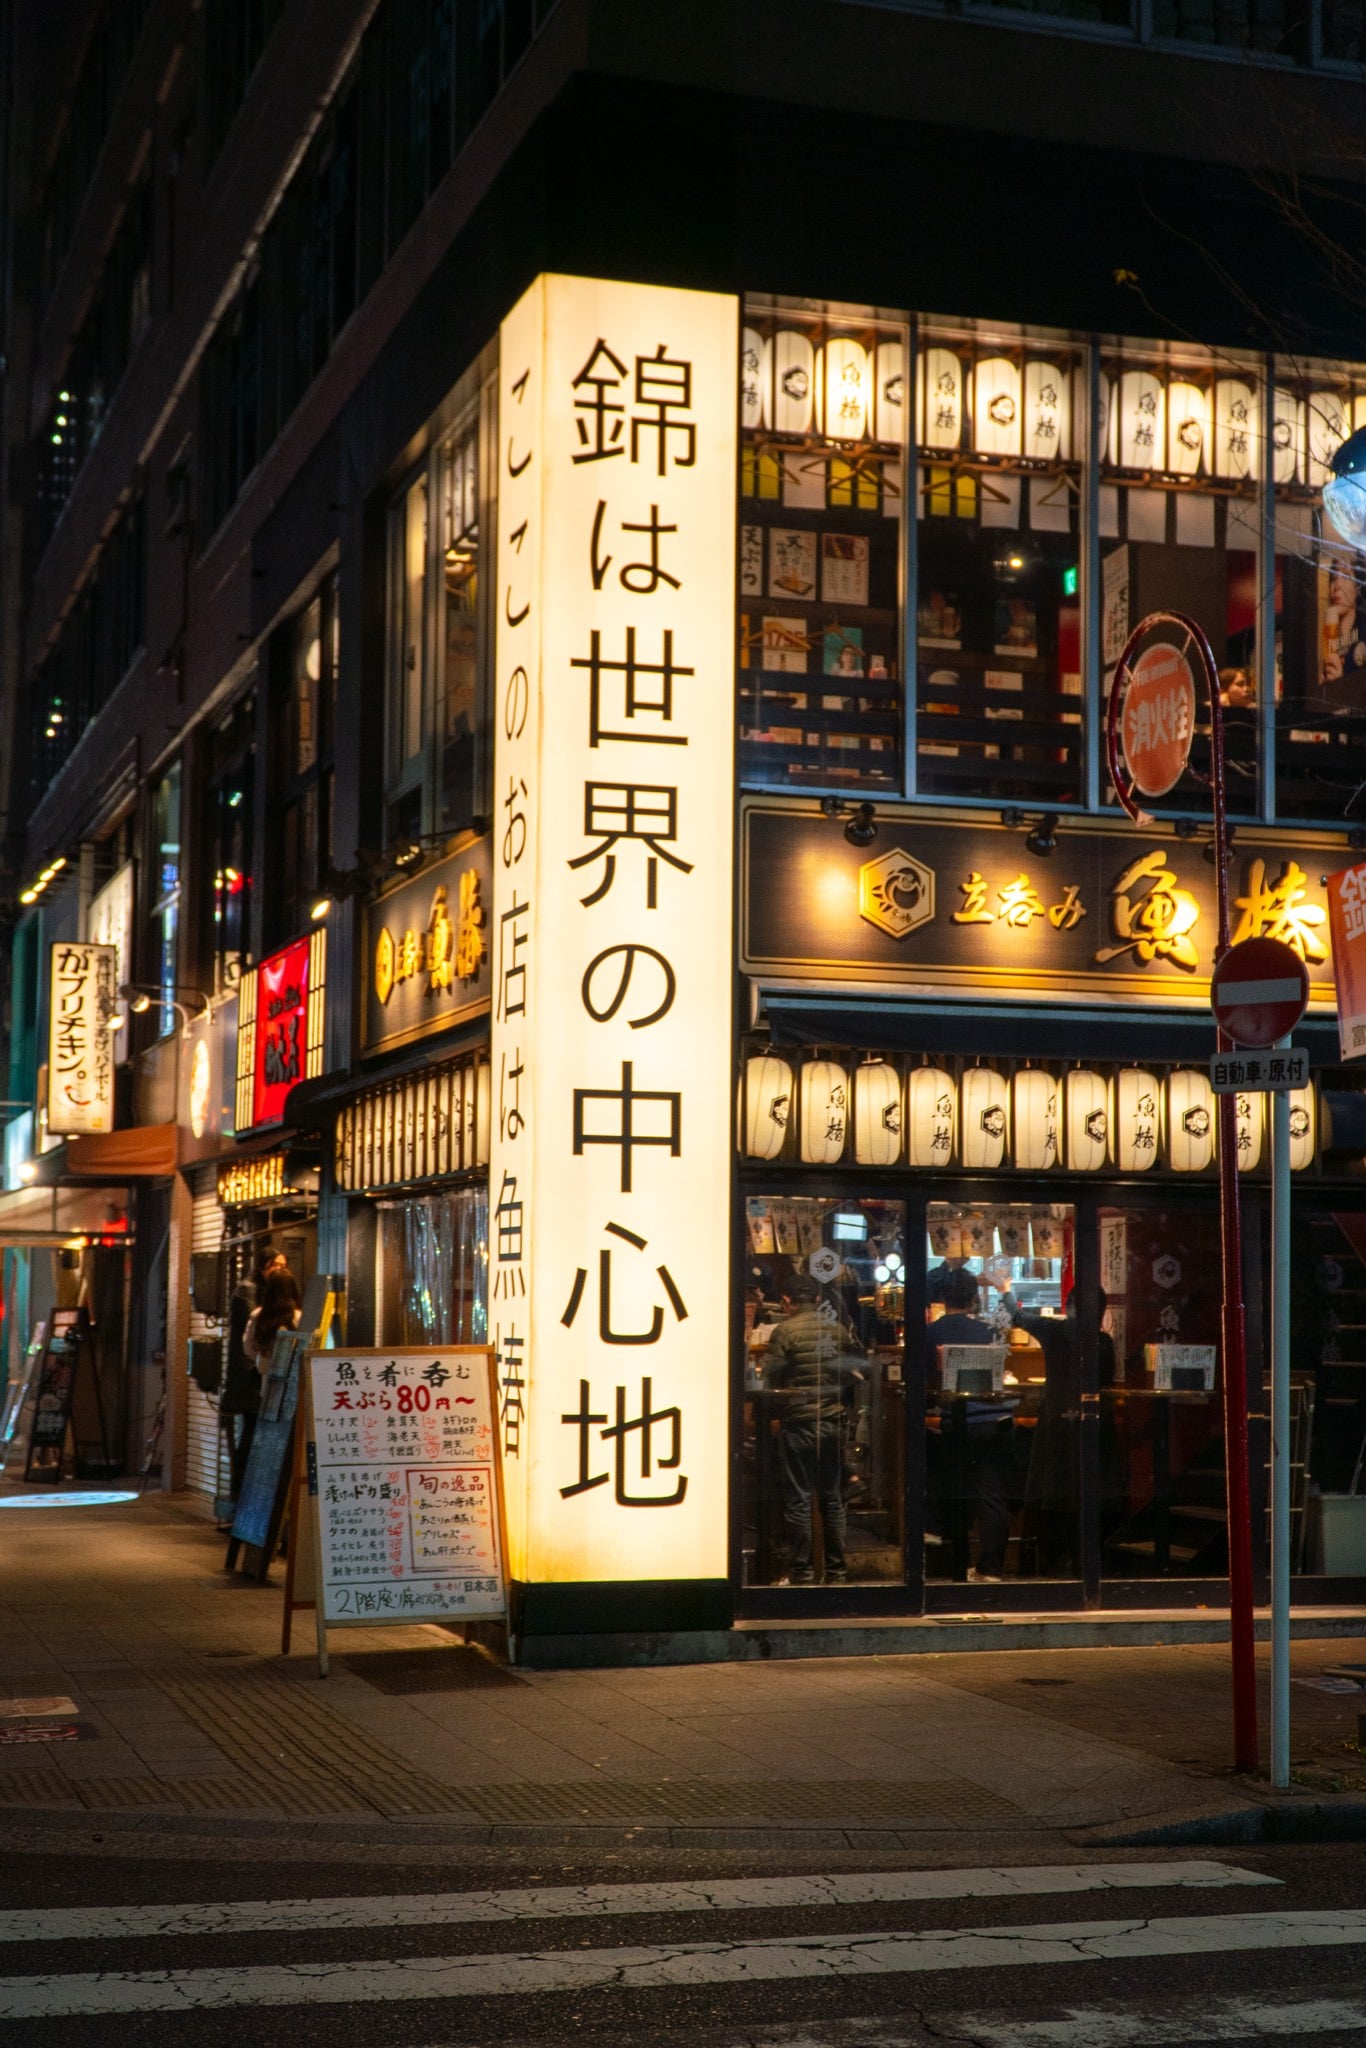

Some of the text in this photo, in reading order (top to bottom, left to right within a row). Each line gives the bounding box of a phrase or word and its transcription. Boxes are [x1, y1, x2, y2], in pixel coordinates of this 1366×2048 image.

[1129, 684, 1189, 757] 消火栓
[560, 337, 699, 1508] 錦は世界の中心地
[953, 850, 1330, 967] 立呑み 魚椿
[57, 948, 94, 1080] がブリチキン。
[1215, 1058, 1304, 1085] 自動車・原付
[825, 1085, 845, 1142] 魚椿
[931, 1094, 951, 1150] 魚椿
[1132, 1093, 1155, 1149] 魚椿
[335, 1361, 470, 1388] 魚を肴に呑む
[418, 1474, 484, 1494] 旬の逸品
